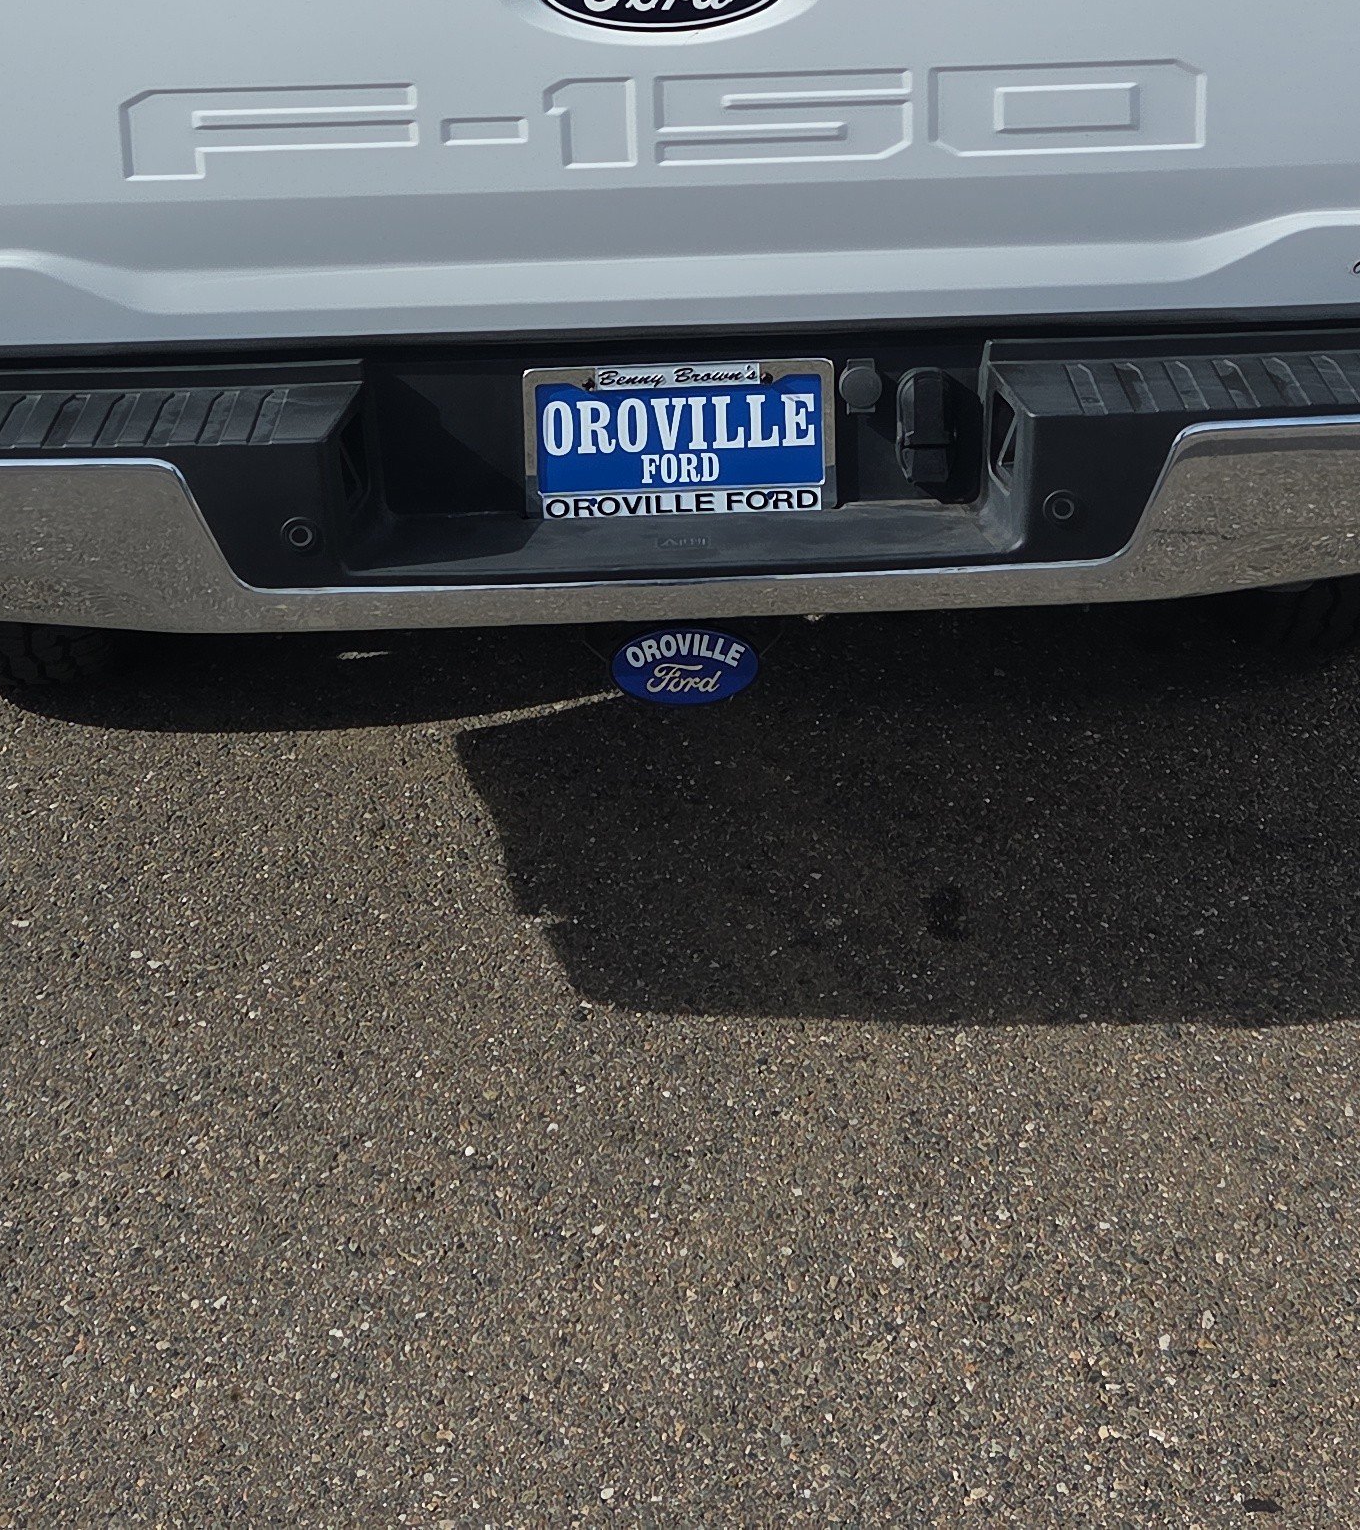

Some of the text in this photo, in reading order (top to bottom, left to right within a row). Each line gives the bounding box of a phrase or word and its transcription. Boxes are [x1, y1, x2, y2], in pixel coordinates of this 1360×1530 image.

[120, 58, 1206, 181] F-150
[598, 364, 759, 388] Benny Brown's
[542, 393, 816, 456] OROVILLE
[641, 452, 721, 484] FORD
[545, 489, 820, 519] OROVILLE FORD
[625, 632, 747, 669] OROVILLE
[645, 663, 723, 694] Ford
